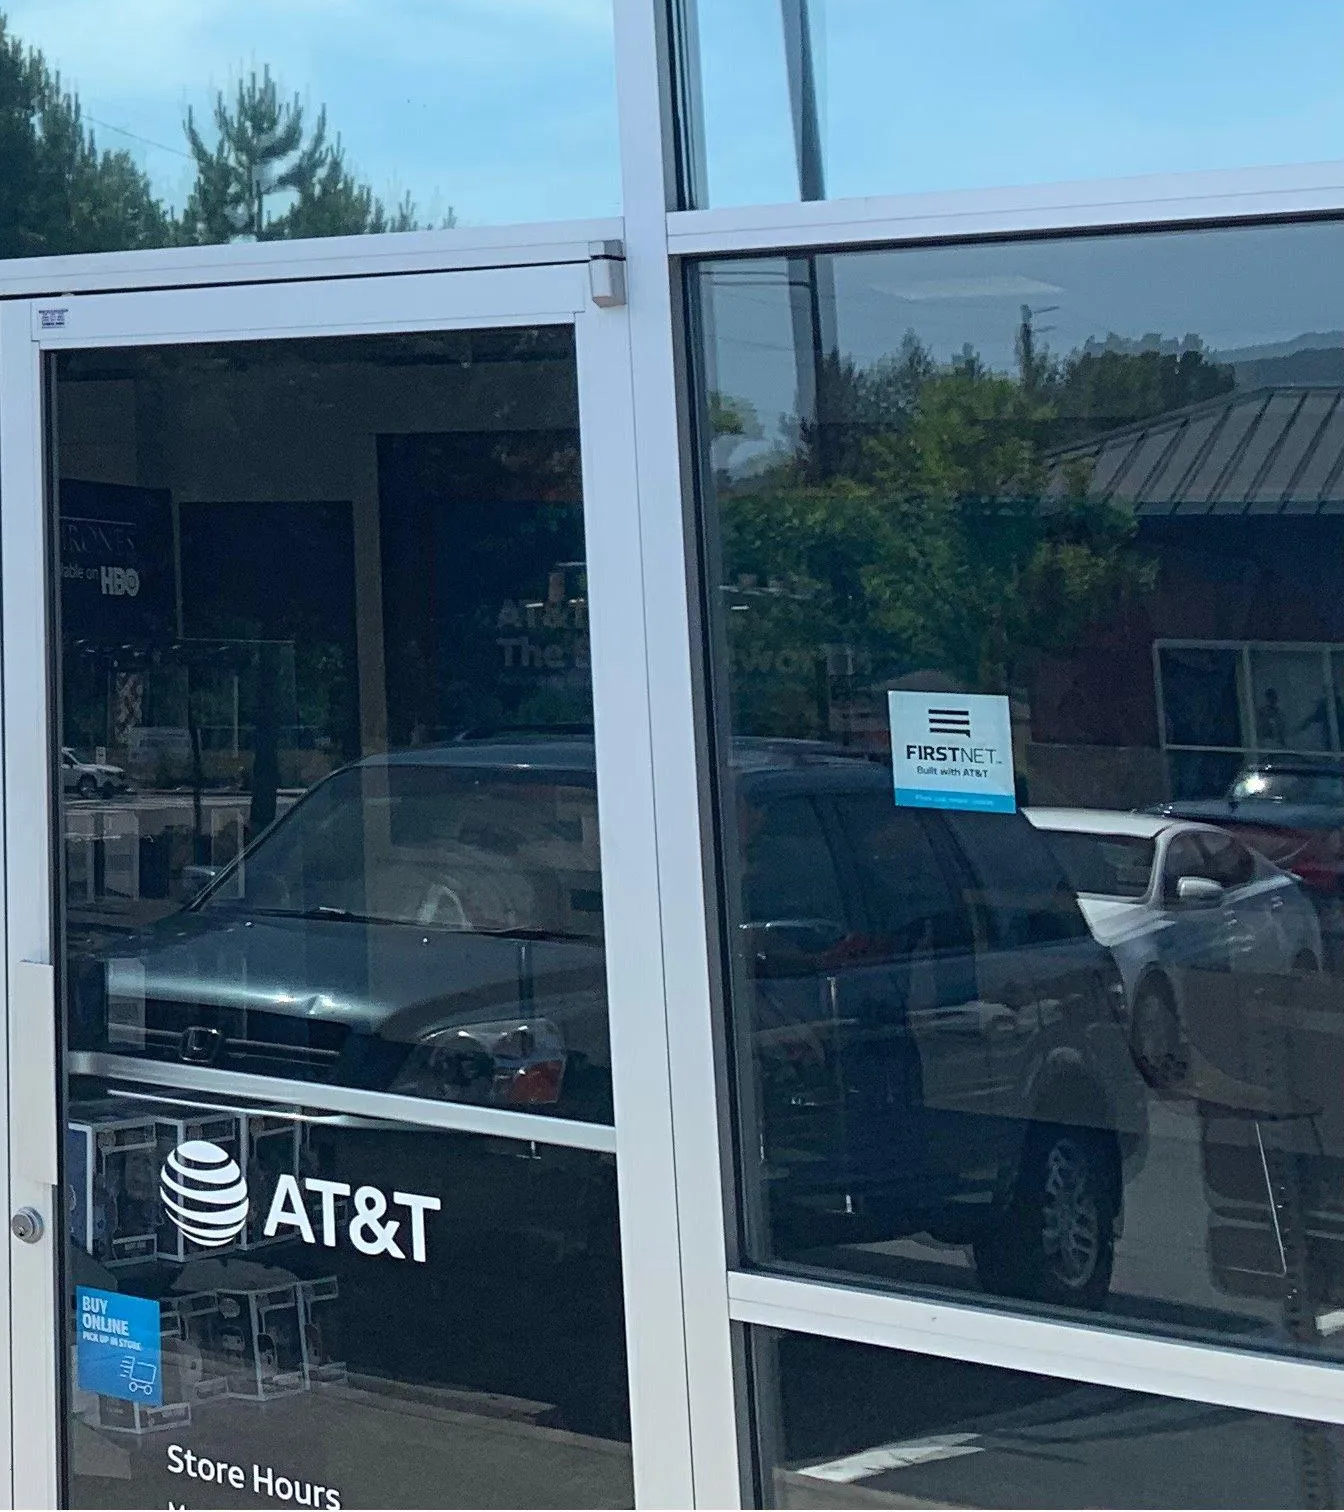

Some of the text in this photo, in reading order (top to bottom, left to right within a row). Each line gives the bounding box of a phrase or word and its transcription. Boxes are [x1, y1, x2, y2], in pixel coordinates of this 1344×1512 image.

[101, 566, 141, 597] HBO
[916, 765, 989, 778] Built with AT&T
[263, 1173, 442, 1263] AT&T
[82, 1295, 108, 1315] BUY
[82, 1313, 130, 1337] ONLINE
[82, 1331, 99, 1342] PICK
[100, 1335, 109, 1343] UP
[110, 1337, 118, 1346] IN
[167, 1444, 342, 1511] Store Hours
